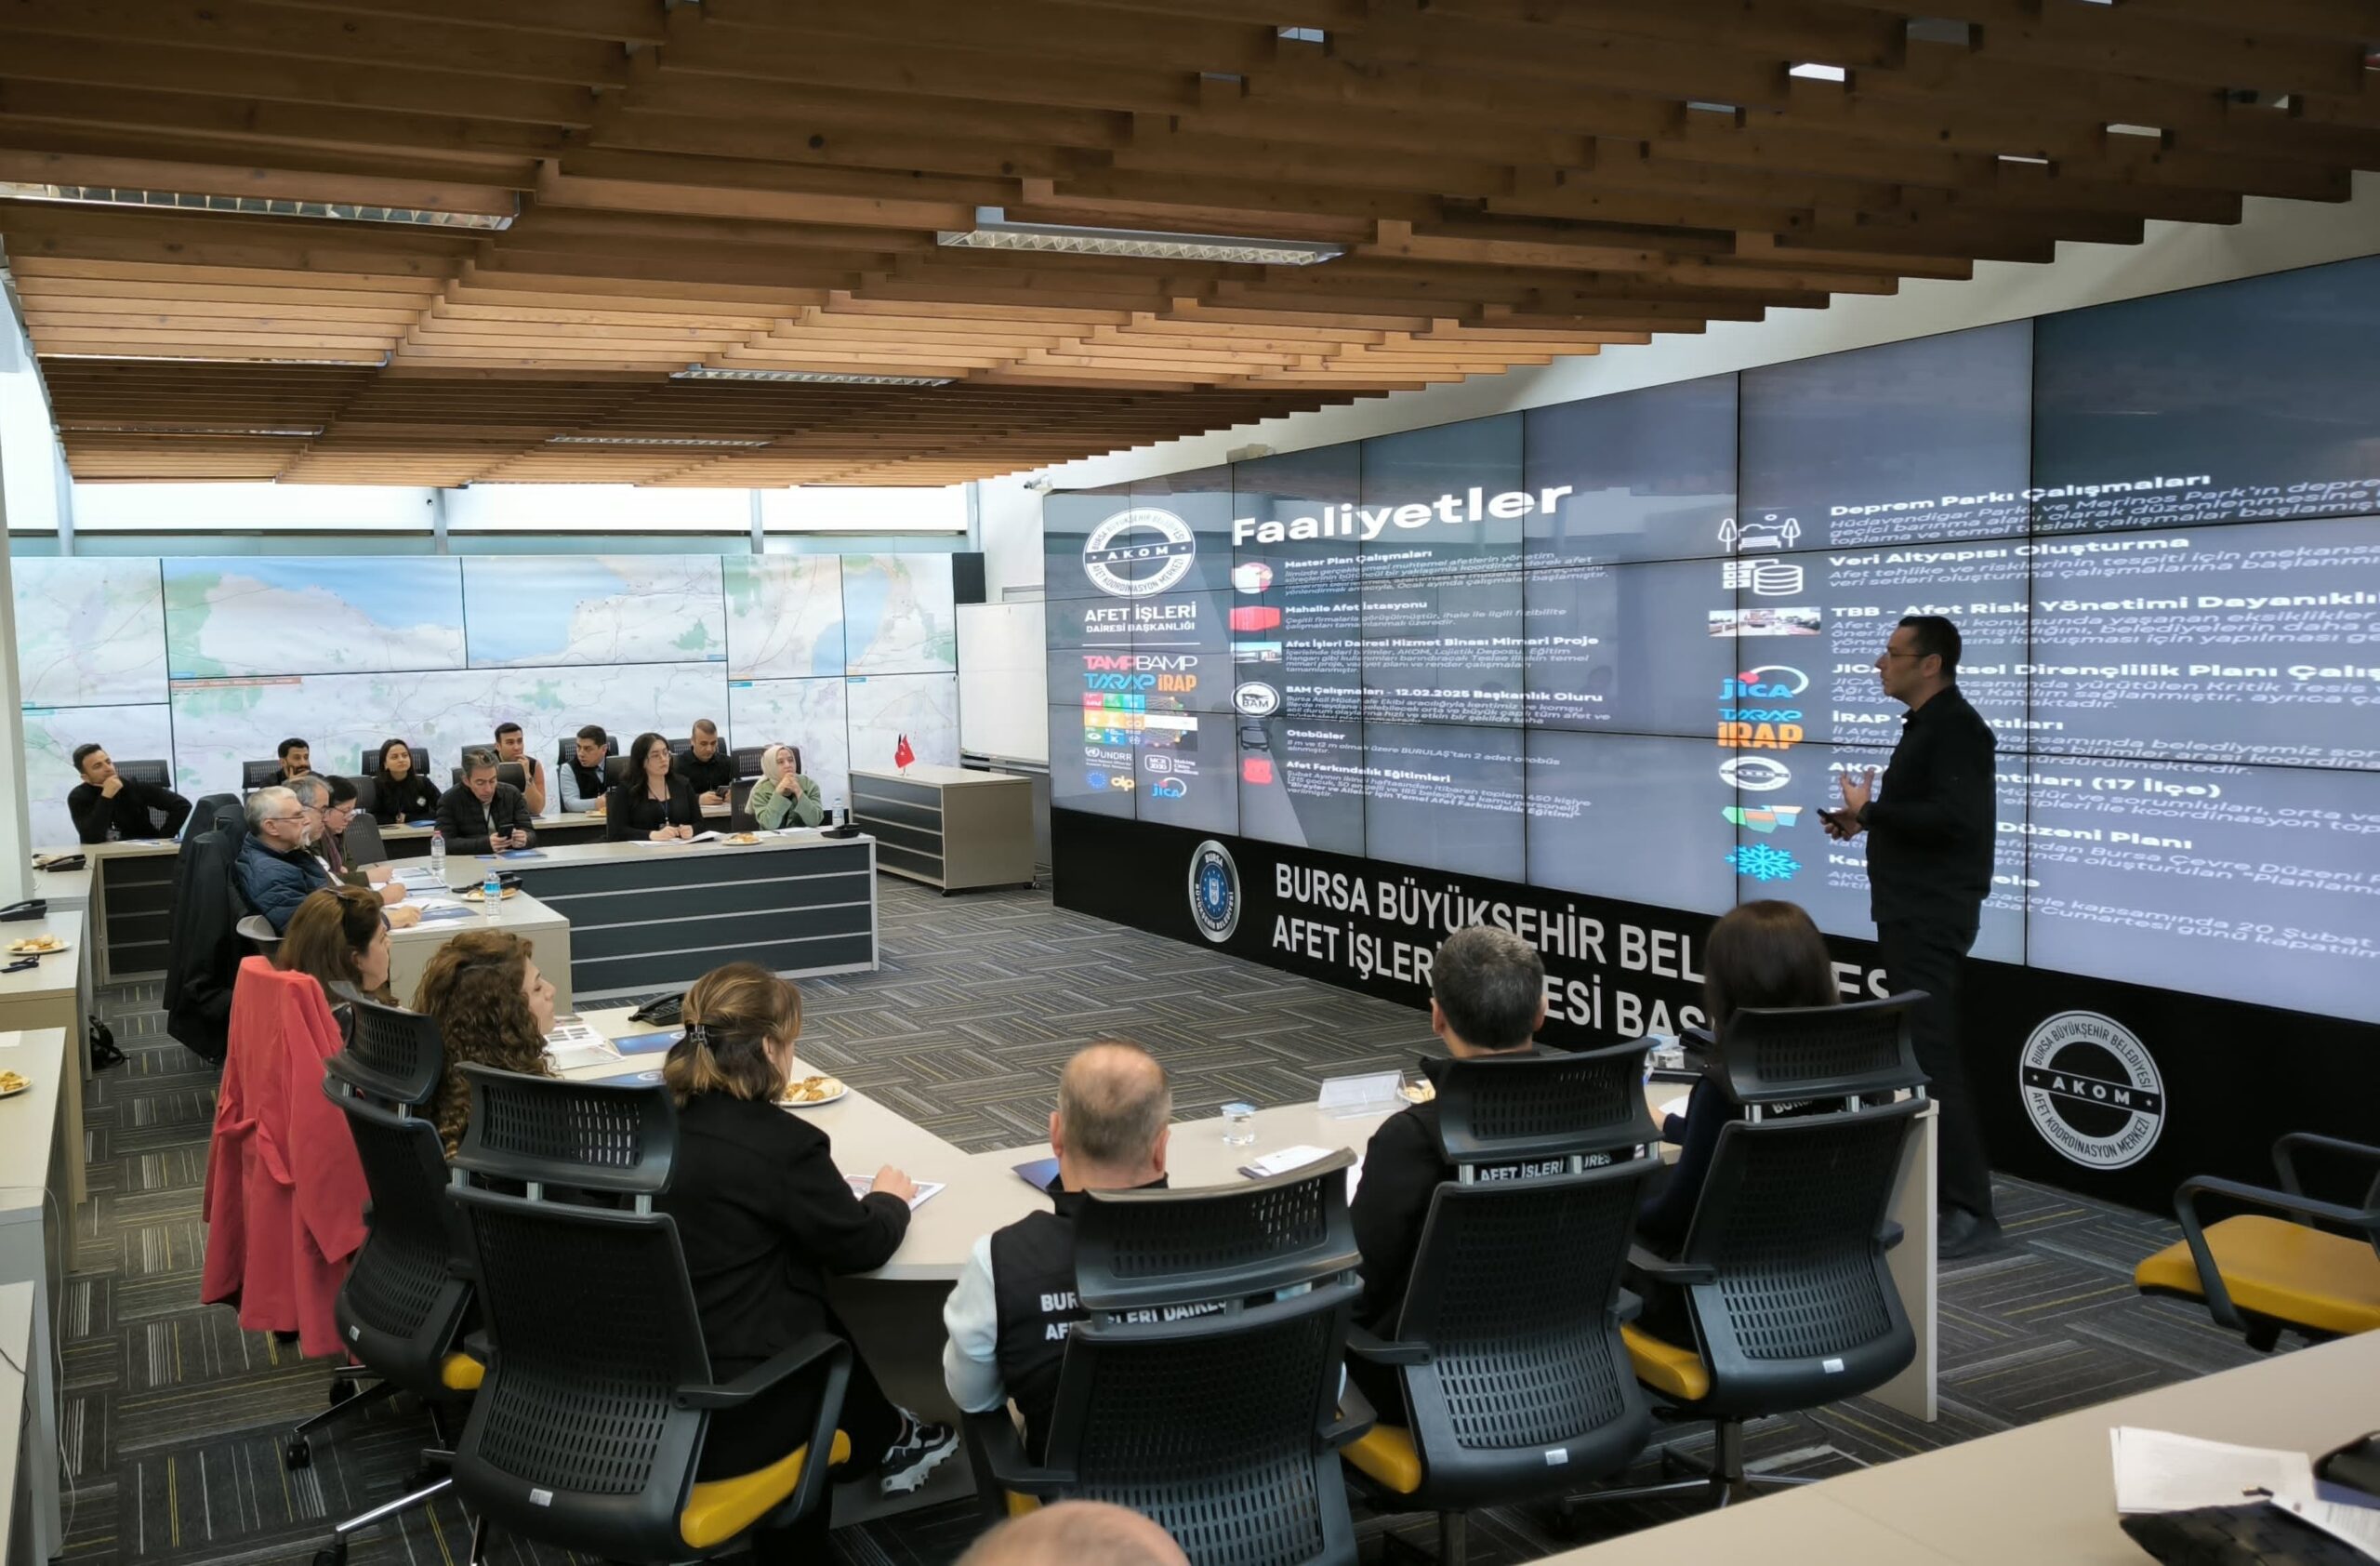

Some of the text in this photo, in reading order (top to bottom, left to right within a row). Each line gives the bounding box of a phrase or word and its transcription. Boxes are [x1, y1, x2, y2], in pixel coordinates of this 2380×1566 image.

[1831, 475, 2211, 516] Deprem Parkı Çalışmaları
[1233, 484, 1573, 546] Faaliyetler
[1830, 511, 1975, 529] Hüdavendigar
[2043, 502, 2069, 512] ve
[2075, 495, 2177, 511] Merinos
[1830, 524, 1891, 538] geçici
[1894, 519, 1981, 534] barınma
[2048, 507, 2125, 522] olarak
[2130, 491, 2369, 514] düzenlenmesine
[1831, 532, 1912, 546] toplama
[1917, 529, 1941, 539] ve
[1947, 524, 2012, 537] temel
[2095, 511, 2233, 529] çalışmalar
[1107, 546, 1169, 560] AKOM
[1285, 551, 1433, 568] Master Plan Çalışmaları
[1829, 537, 2189, 566] Veri Altyapısı Oluşturma
[1829, 569, 1870, 579] Afet
[1874, 566, 1945, 577] tehlike
[1950, 565, 1975, 574] ve
[2103, 553, 2186, 567] tespiti
[2192, 551, 2241, 563] için
[1830, 578, 1865, 588] veri
[2060, 562, 2234, 579] çalışmalarına
[1084, 601, 1197, 623] AFET İŞLERİ
[1332, 604, 1360, 613] Afet
[1362, 601, 1428, 612] İstasyonu
[1831, 591, 2380, 617] TBB Afet Risk Yönetimi Dayanıklı
[1086, 621, 1196, 633] DAİRESİ BAŞKANLIĞI
[1831, 621, 1873, 630] Afet
[2109, 615, 2220, 626] yaşanan
[2227, 609, 2377, 623] eksiklikler
[2100, 620, 2360, 635] belediyelerin daha
[1286, 636, 1599, 649] Afet İşleri Dairesi Hizmet Binası Mimari Proje
[2146, 633, 2194, 646] için
[2200, 632, 2339, 646] yapılması
[2014, 663, 2180, 679] Dirençlilik
[2188, 664, 2278, 677] Planı
[1286, 686, 1604, 702] BAM Çalışmaları 12.02.2025 Başkanlık Oluru
[2205, 682, 2281, 693] Kritik
[2291, 682, 2367, 694] Tesis
[2251, 694, 2343, 705] ayrıca
[1242, 698, 1270, 708] BAM
[1287, 729, 1346, 740] Otobüsler
[2151, 739, 2323, 755] belediyemiz
[1287, 761, 1451, 784] Afet Farkındalık Eğitimleri
[1828, 762, 2222, 798] AKO (17 İlçe)
[2077, 793, 2106, 803] ve
[2278, 807, 2342, 820] orta
[2131, 805, 2320, 828] koordinasyon
[1996, 821, 2192, 850] Düzeni Planı
[2091, 846, 2363, 883] Bursa Çevre Düzeni
[1276, 862, 1370, 916] BURSA
[2040, 906, 2249, 942] Cumartesi günü
[2070, 899, 2374, 948] kapsamında 20 Şubat
[1272, 914, 1444, 989] AFET İŞLER
[2031, 1020, 2155, 1089] BURSA BÜYÜKŞEHİR BELEDİYESİ
[2052, 1076, 2131, 1105] AKOM
[2032, 1091, 2150, 1159] AFET KOORDİNASYON MERKEZİ
[1480, 1166, 1518, 1182] AFET
[1040, 1292, 1078, 1312] BUR
